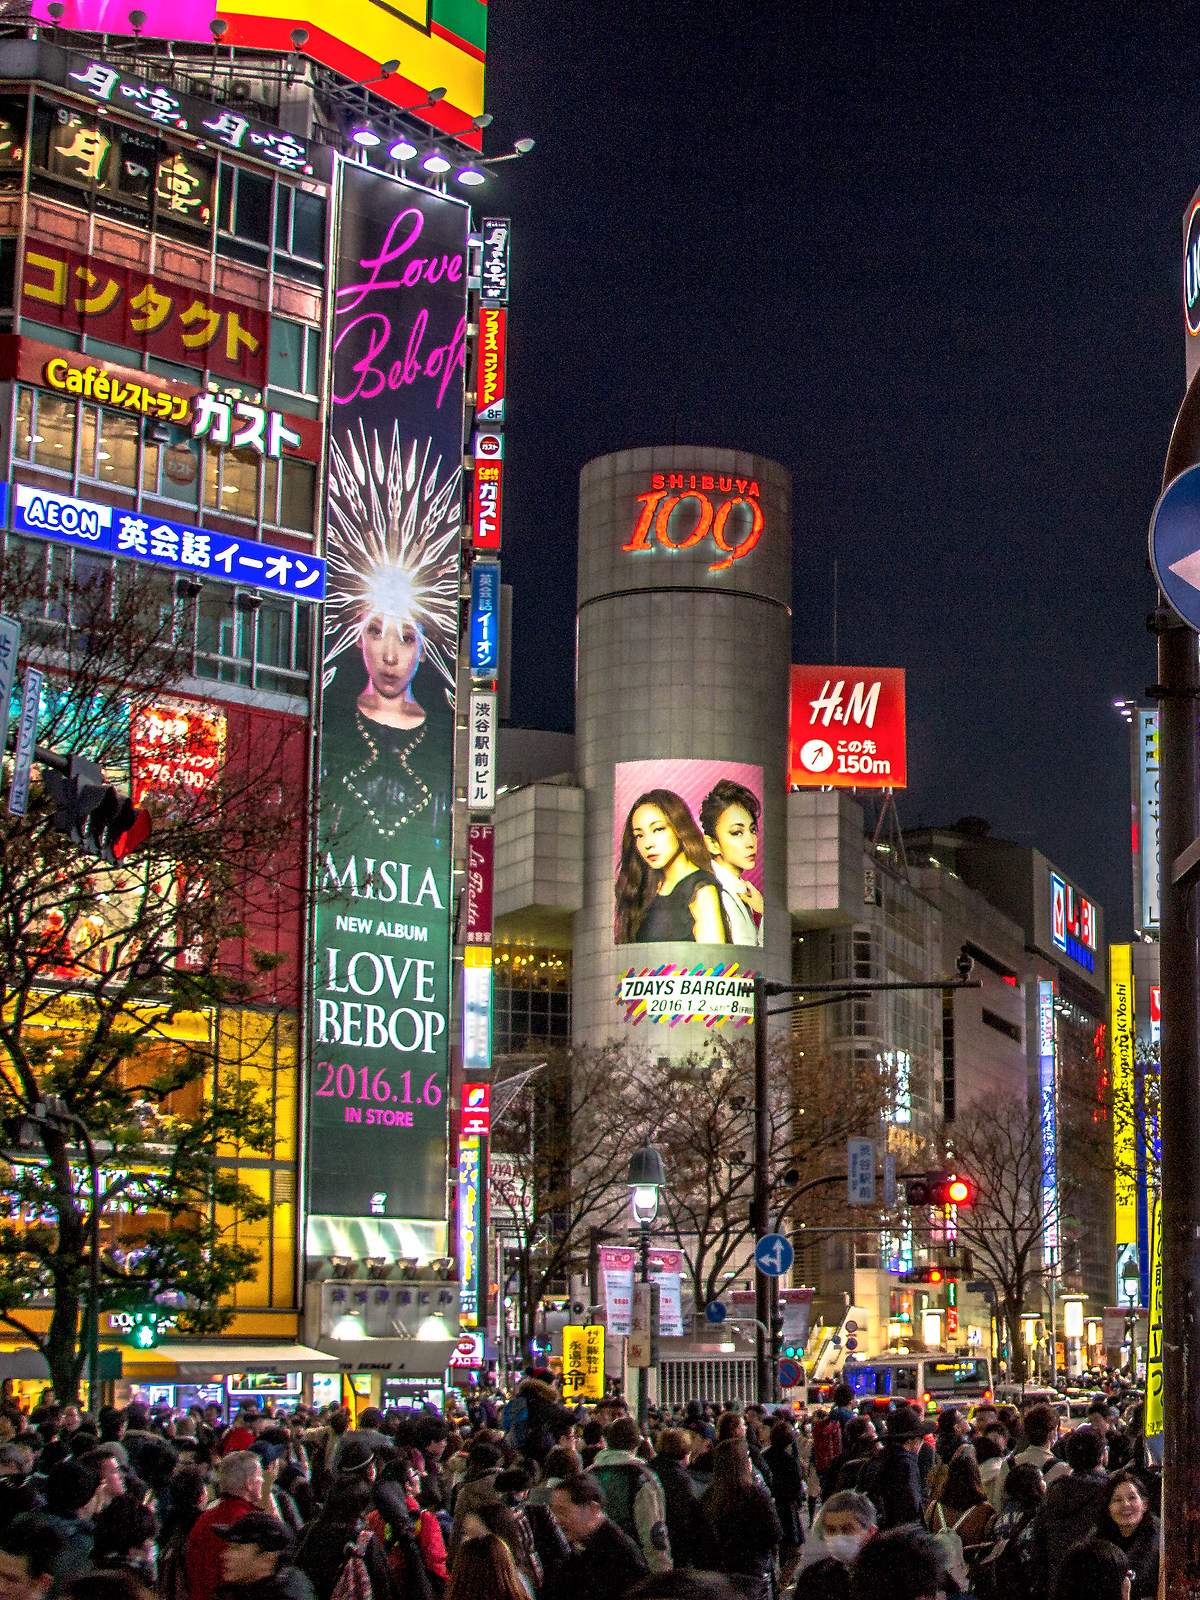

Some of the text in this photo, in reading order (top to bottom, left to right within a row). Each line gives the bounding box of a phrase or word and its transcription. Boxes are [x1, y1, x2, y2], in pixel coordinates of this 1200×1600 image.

[336, 207, 463, 314] Love
[24, 251, 262, 362] コンタクト
[193, 391, 301, 457] ガスト
[487, 409, 502, 419] 8F
[477, 481, 497, 537] ガスト
[652, 474, 760, 497] SHIBUYA
[27, 498, 98, 533] AEON
[622, 490, 764, 571] 109
[477, 612, 492, 665] イーオン
[809, 680, 881, 728] H&M
[475, 703, 490, 800] 渋谷駅前ビル
[837, 740, 876, 753] この先
[837, 756, 890, 774] 150m
[470, 826, 493, 839] 5F
[322, 851, 445, 909] MISIA
[336, 914, 428, 942] NEW ALBUM
[326, 947, 436, 1004] LOVE
[624, 980, 752, 998] 7DAYS BARGAIN
[316, 998, 446, 1054] BEBOP
[651, 1000, 706, 1012] 2016.1.2
[316, 1061, 442, 1107] 2016.1.6
[345, 1106, 414, 1128] IN STORE
